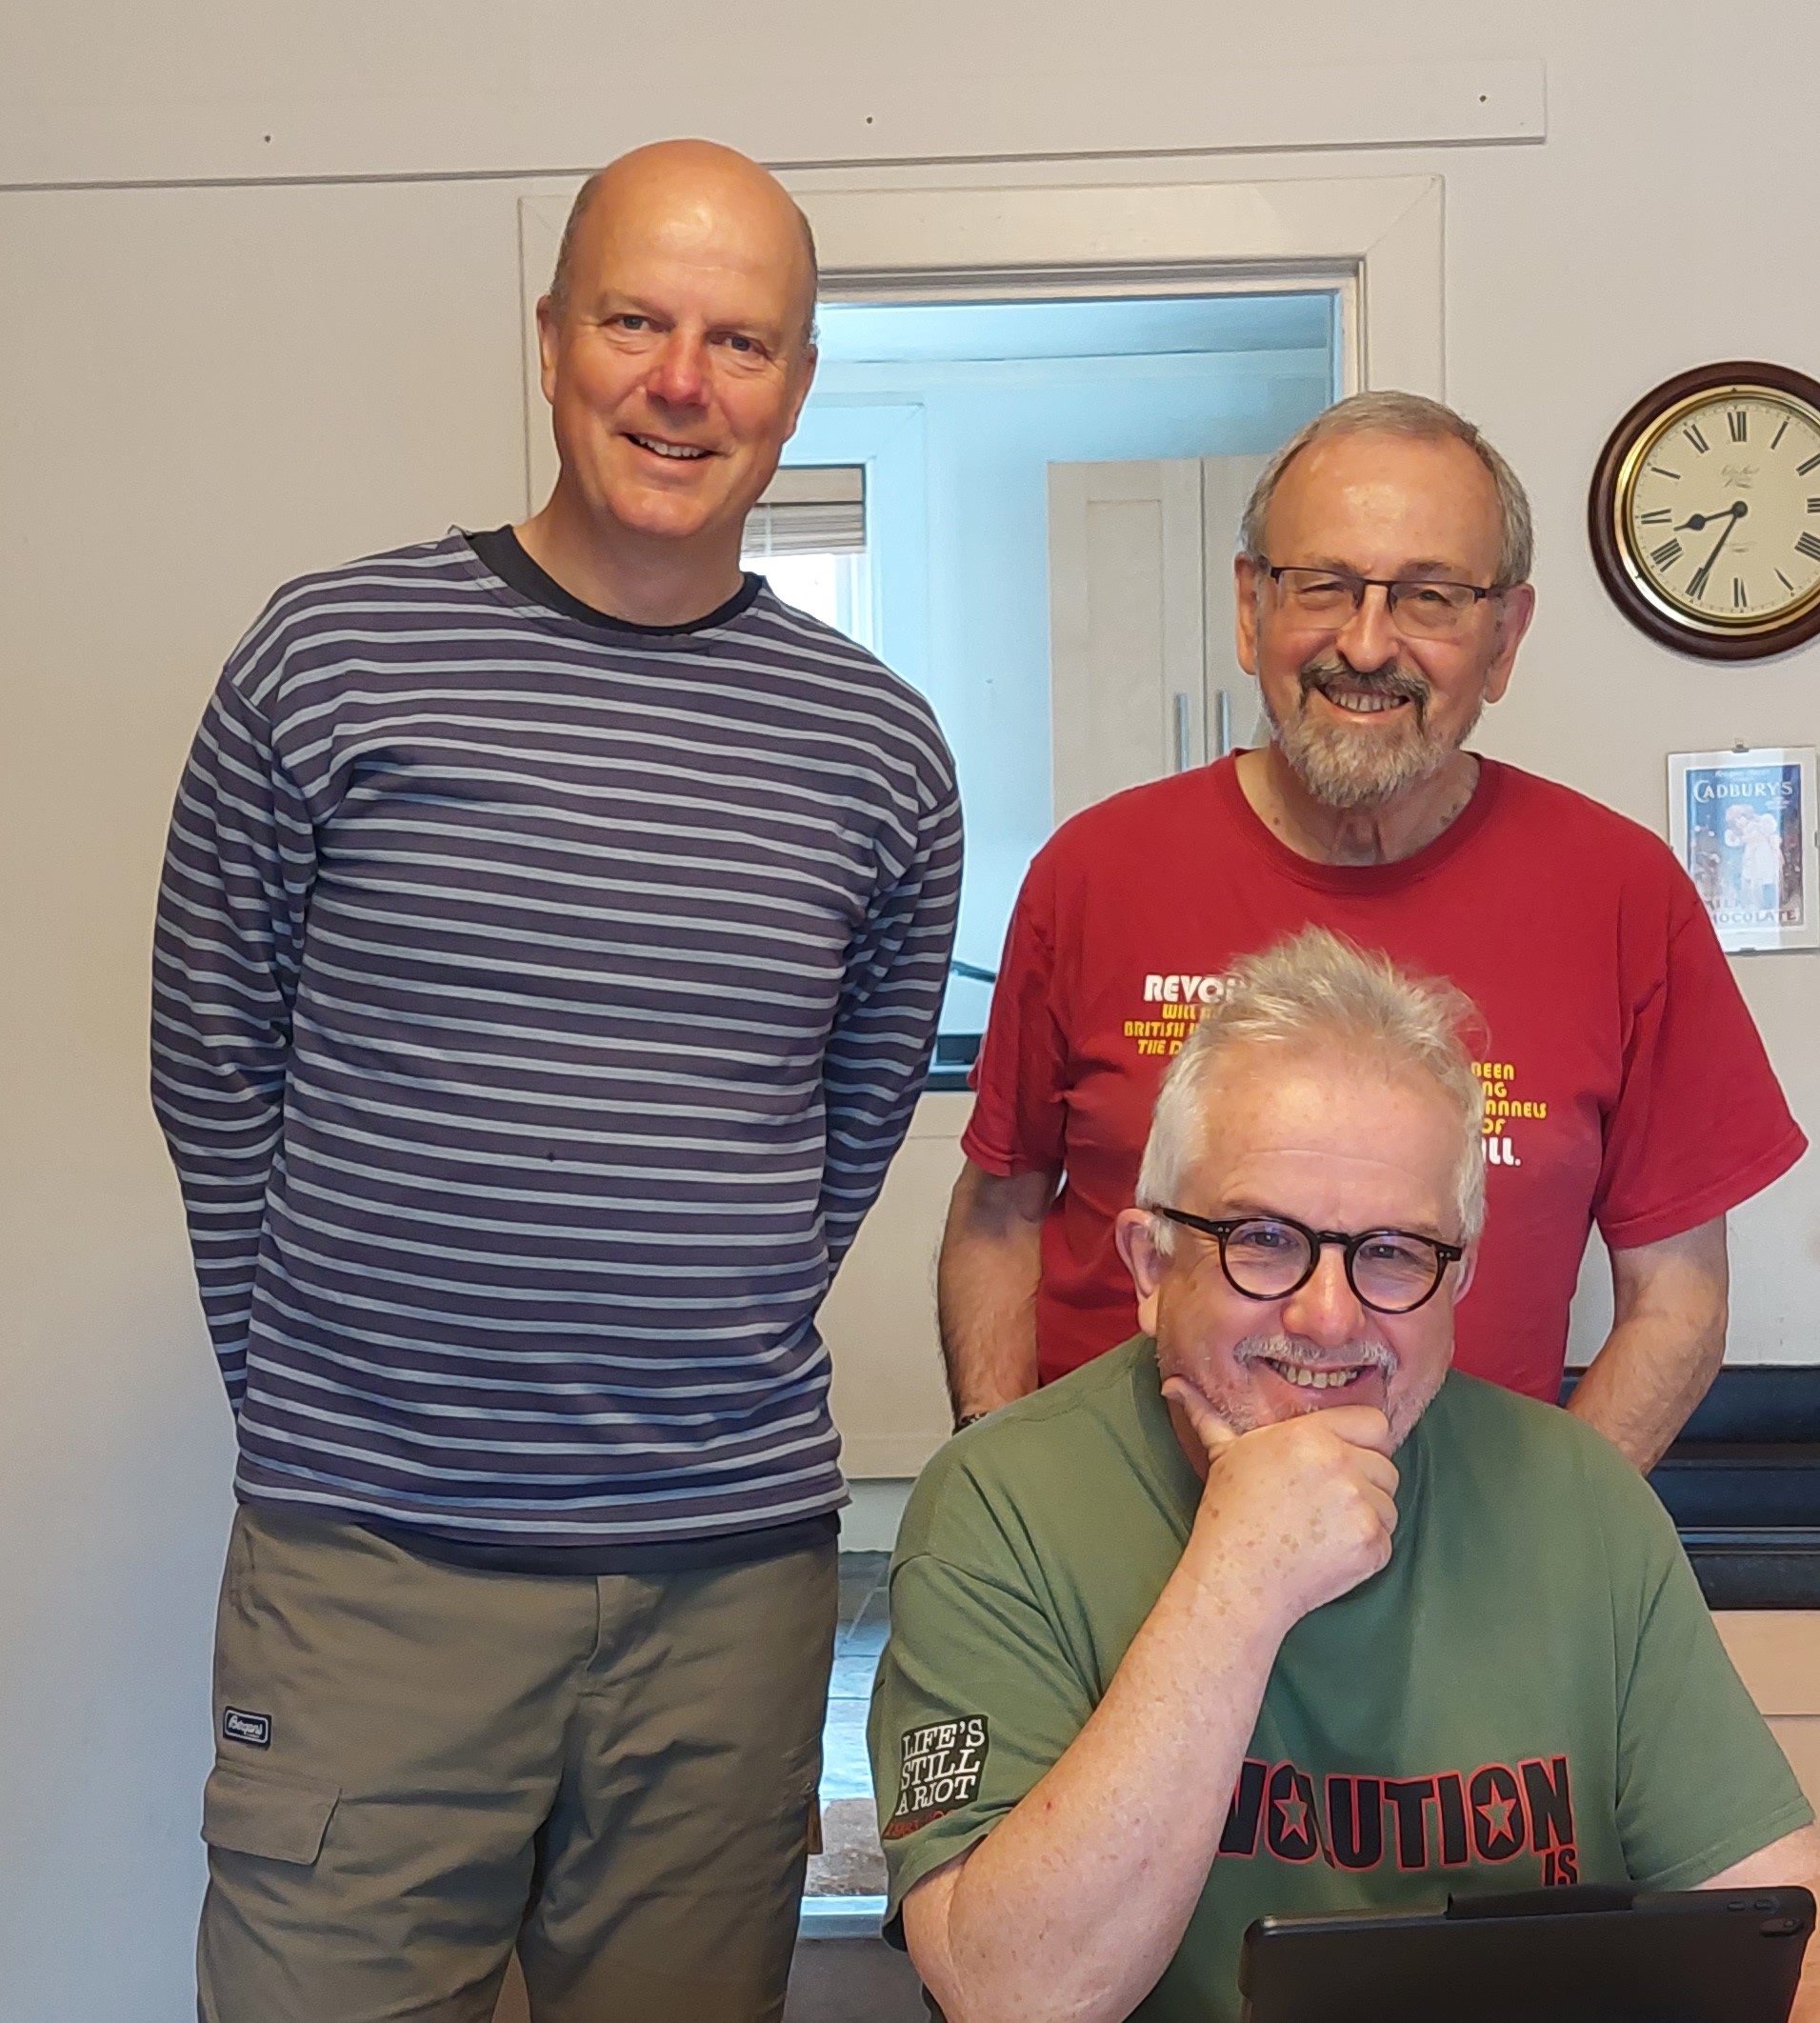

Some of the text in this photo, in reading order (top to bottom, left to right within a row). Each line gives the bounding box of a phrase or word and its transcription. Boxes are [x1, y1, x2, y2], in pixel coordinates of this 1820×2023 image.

[1162, 1004, 1197, 1020] WILL
[1124, 1021, 1186, 1037] BRITISH
[1138, 1039, 1167, 1054] THE
[1470, 1061, 1515, 1081] BEEN
[902, 1718, 986, 1762] LIFE'S
[900, 1749, 981, 1791] STILL
[894, 1774, 977, 1816] A RIOT
[1542, 1847, 1579, 1887] IS
